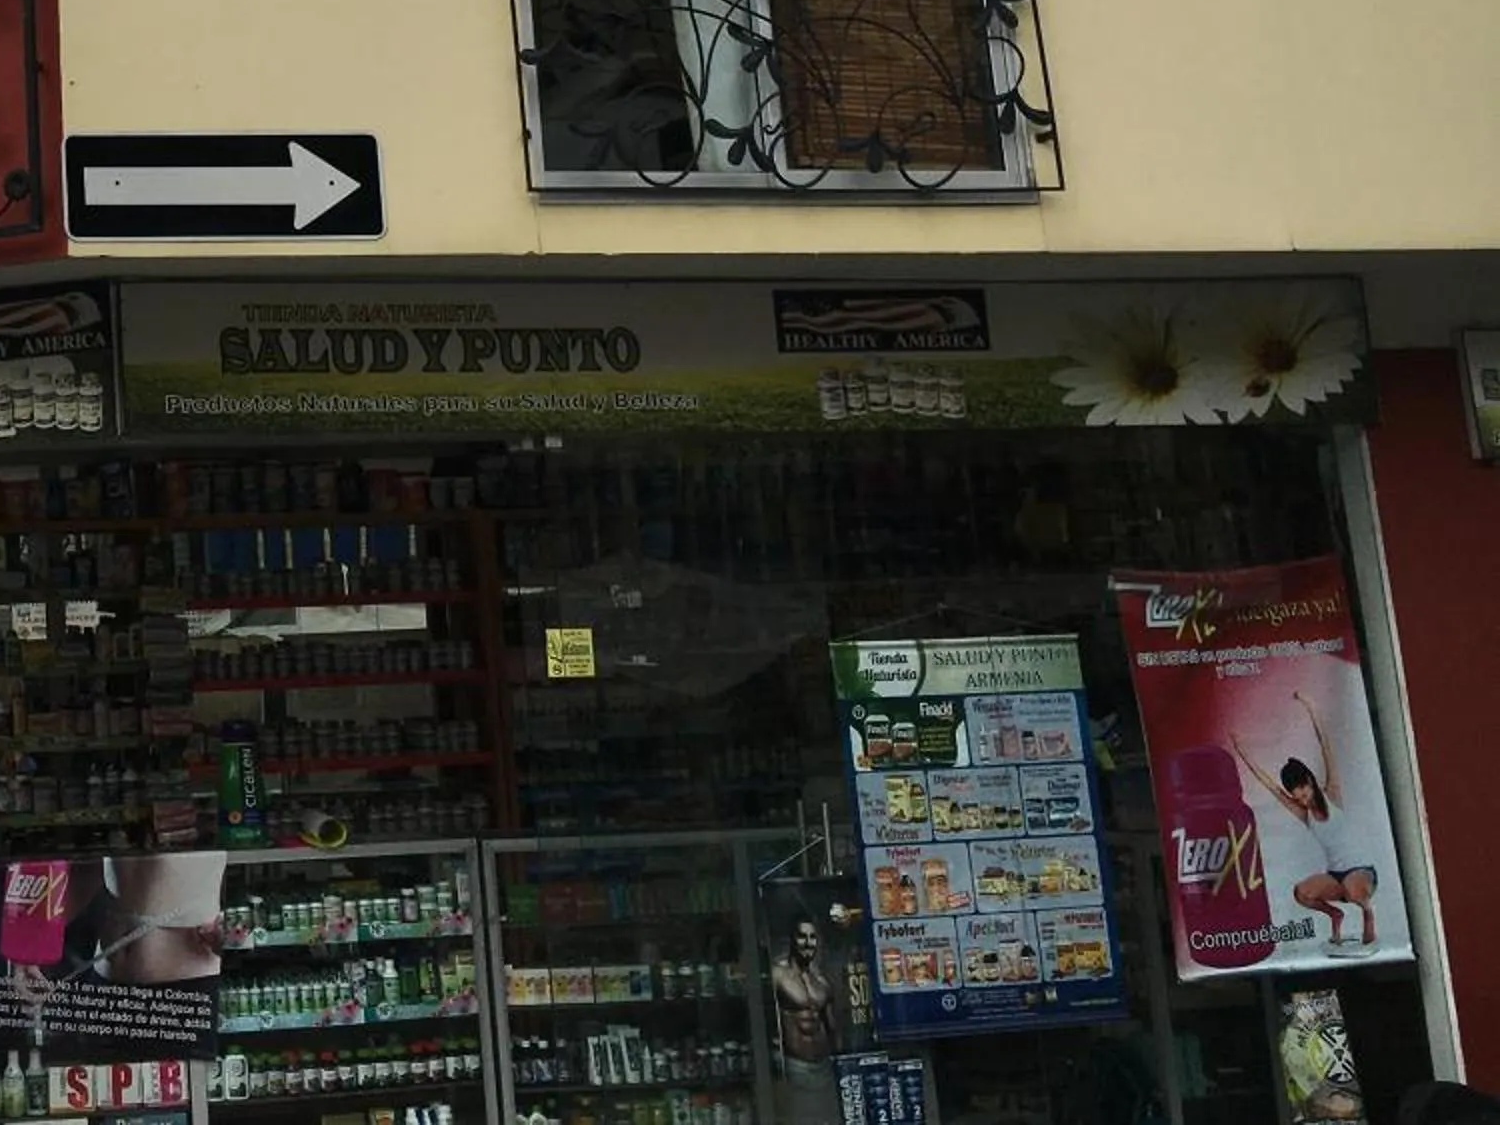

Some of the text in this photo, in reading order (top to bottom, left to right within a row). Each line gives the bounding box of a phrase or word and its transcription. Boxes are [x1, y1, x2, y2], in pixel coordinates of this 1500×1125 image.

[242, 303, 342, 323] TIENDA
[20, 331, 107, 357] AMERICA
[219, 326, 641, 375] SALUD Y PUNTO
[783, 333, 987, 350] HEALTHY AMERICA
[163, 393, 293, 416] Productos
[296, 393, 418, 414] Naturales
[422, 395, 479, 416] para
[517, 393, 587, 412] Salud
[591, 395, 606, 413] y
[613, 392, 700, 412] Belleza
[867, 651, 908, 666] Tienda
[931, 649, 990, 668] SALUD
[1011, 647, 1068, 662] PUNTO
[862, 668, 917, 683] Naturista
[965, 670, 1044, 688] ARMENIA
